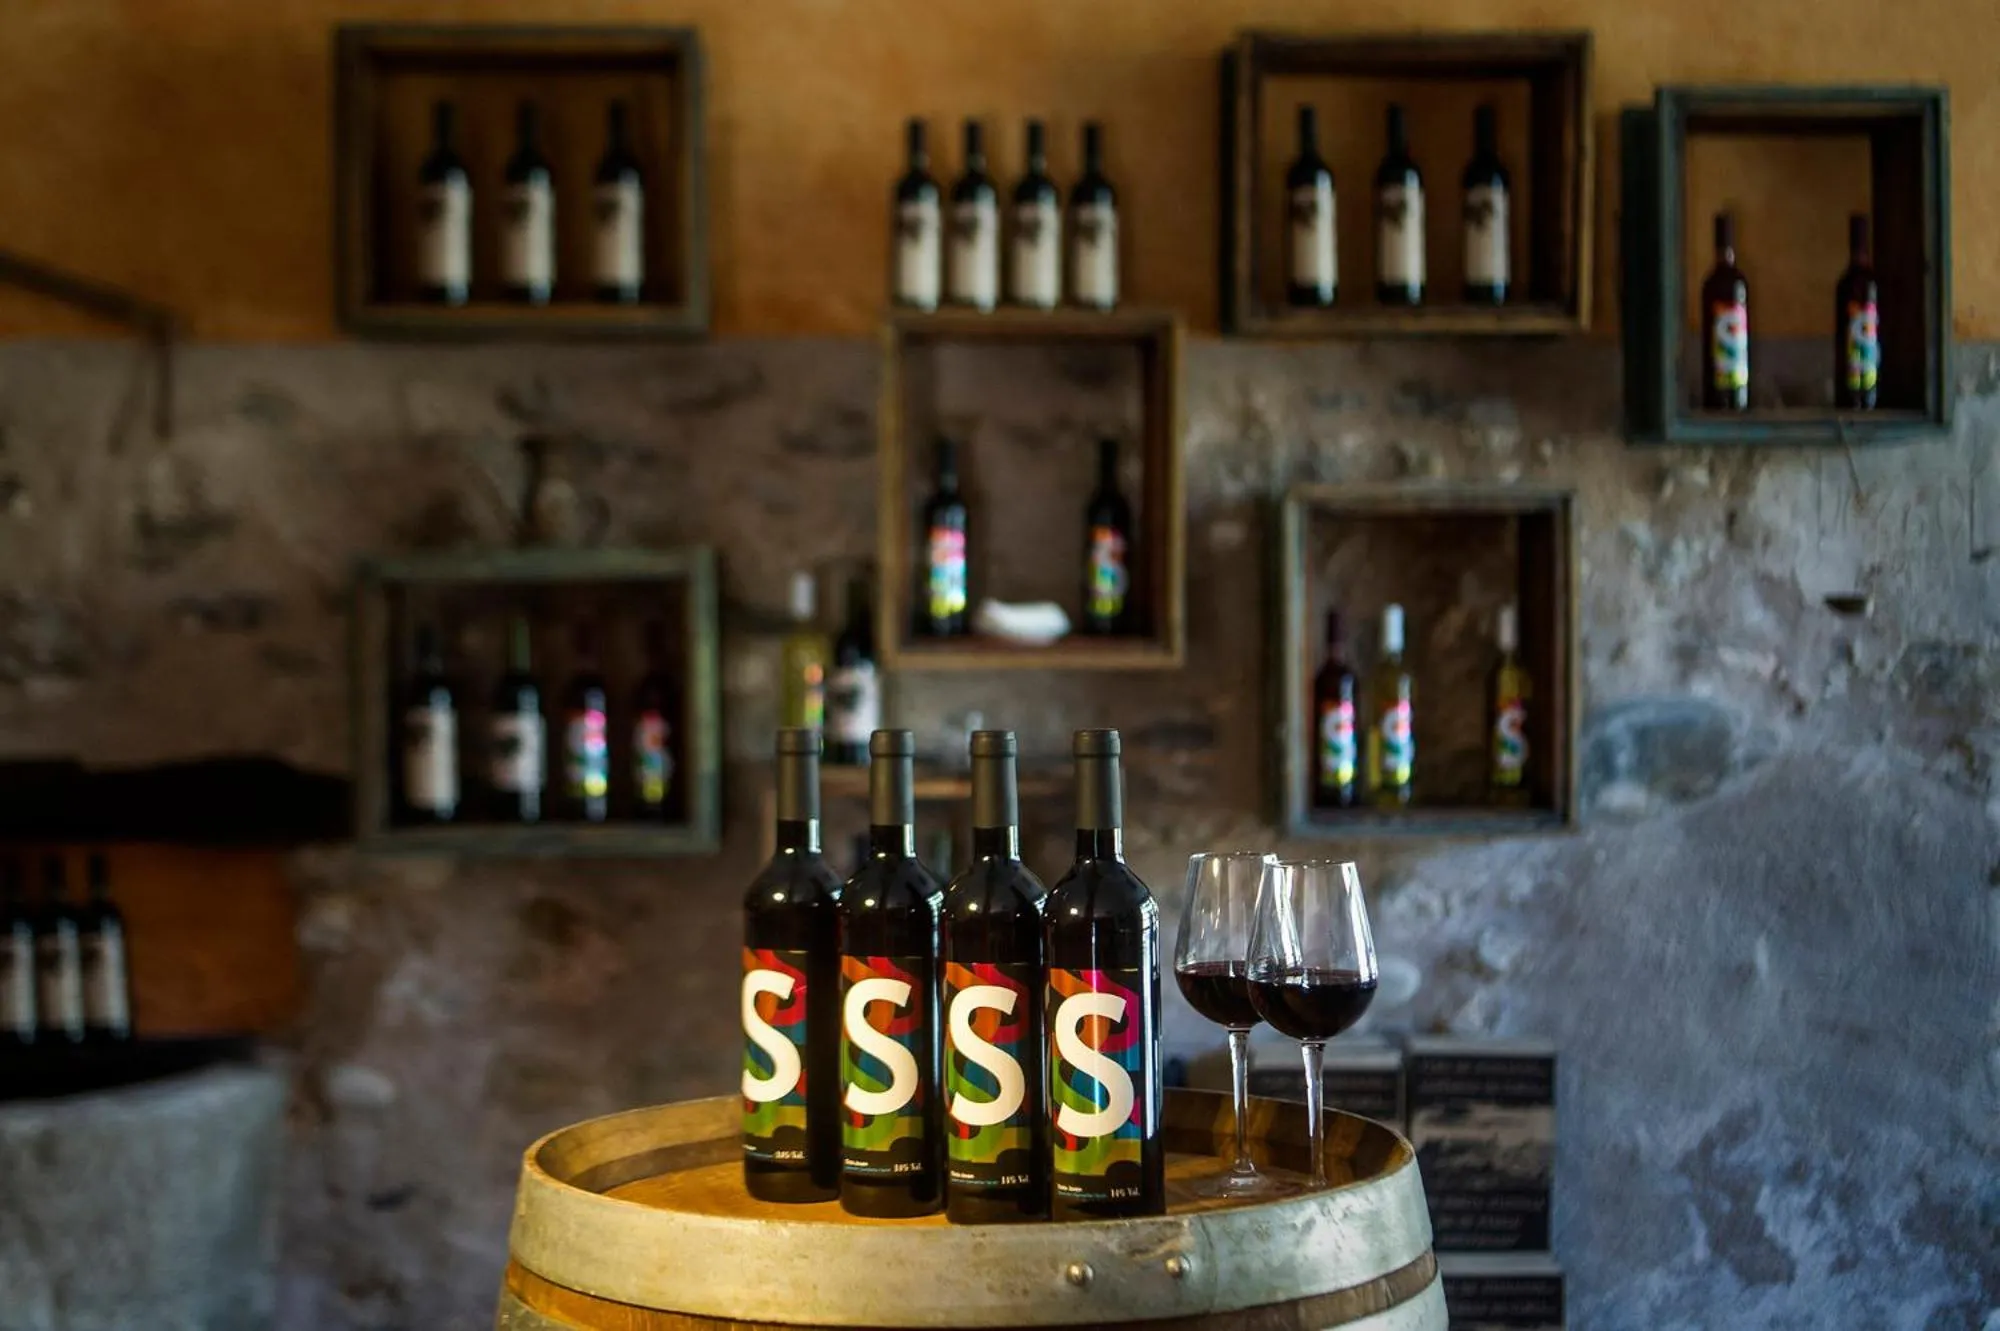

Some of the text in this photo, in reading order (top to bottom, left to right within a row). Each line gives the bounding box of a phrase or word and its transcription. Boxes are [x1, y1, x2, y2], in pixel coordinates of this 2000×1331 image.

[742, 968, 801, 1102] S
[843, 977, 919, 1115] S
[950, 985, 1025, 1126] S
[1055, 992, 1134, 1137] S
